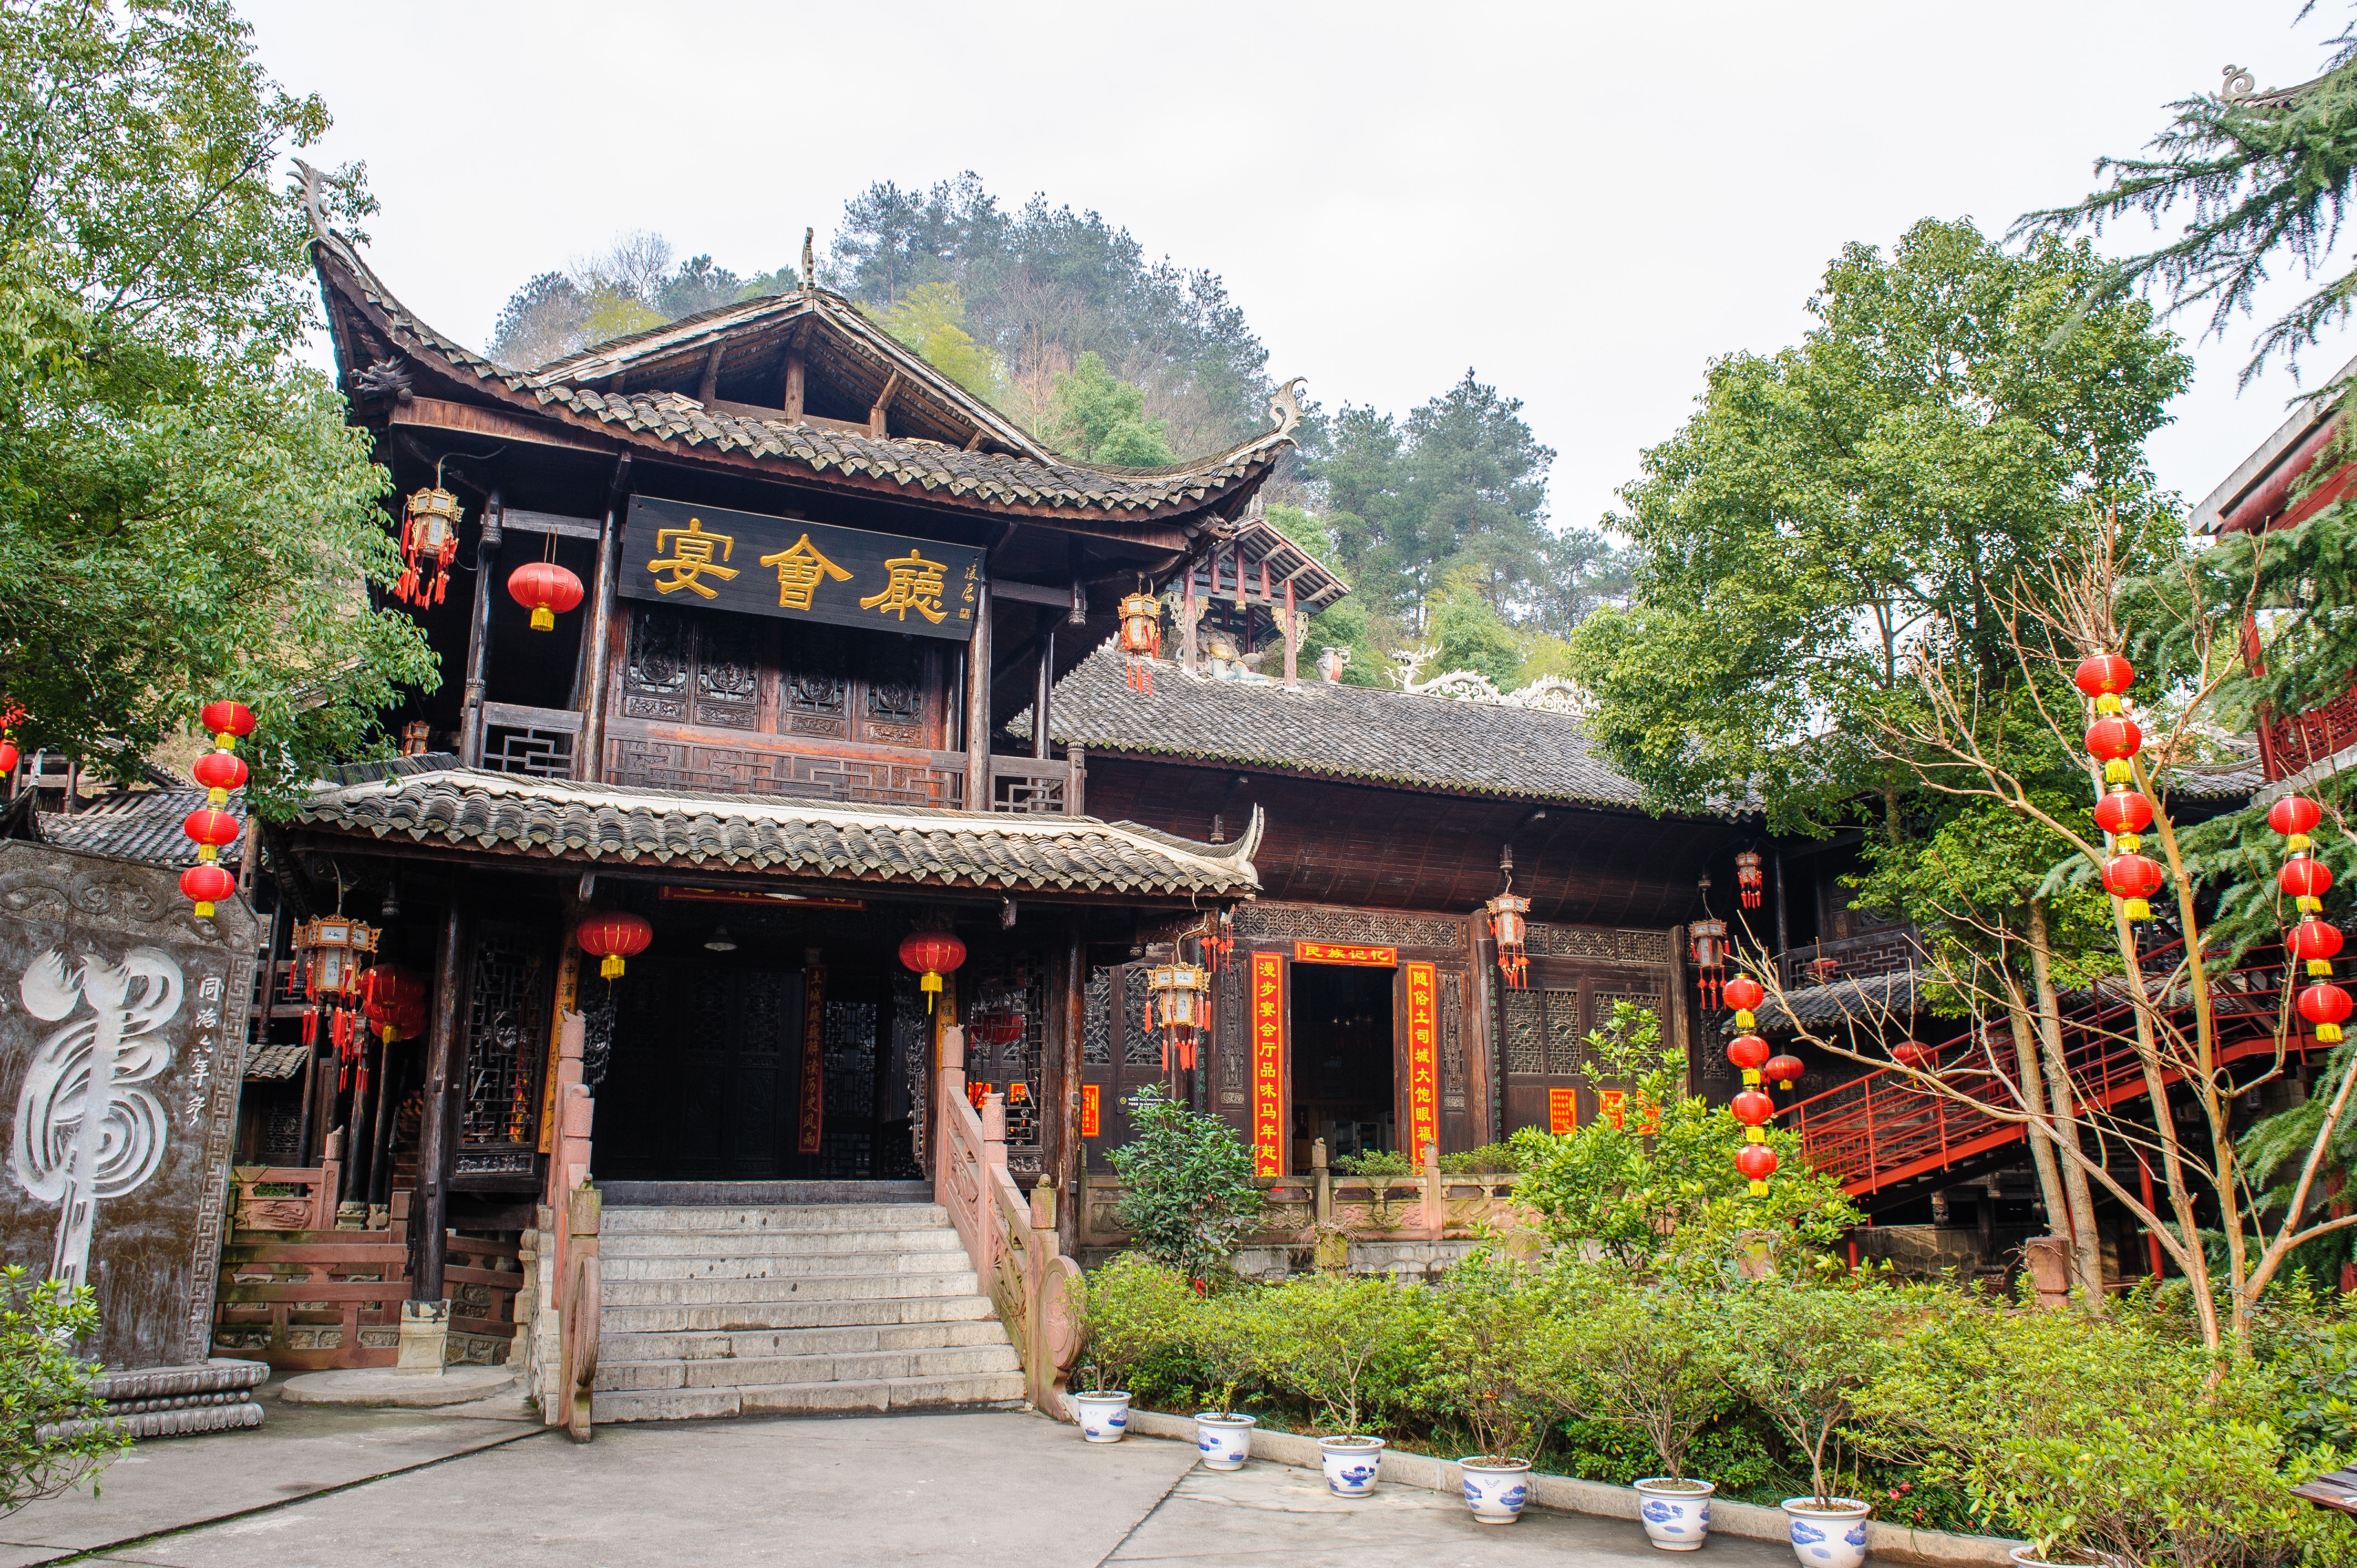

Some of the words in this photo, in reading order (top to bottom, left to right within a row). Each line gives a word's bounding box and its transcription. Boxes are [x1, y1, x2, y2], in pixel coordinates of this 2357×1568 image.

[647, 518, 948, 623] 宴會廳
[1305, 946, 1389, 961] 民族记忆
[1259, 962, 1278, 1177] 漫步宴会厅品味马年赶年
[1413, 971, 1432, 1175] 随俗土司城大饱眼福
